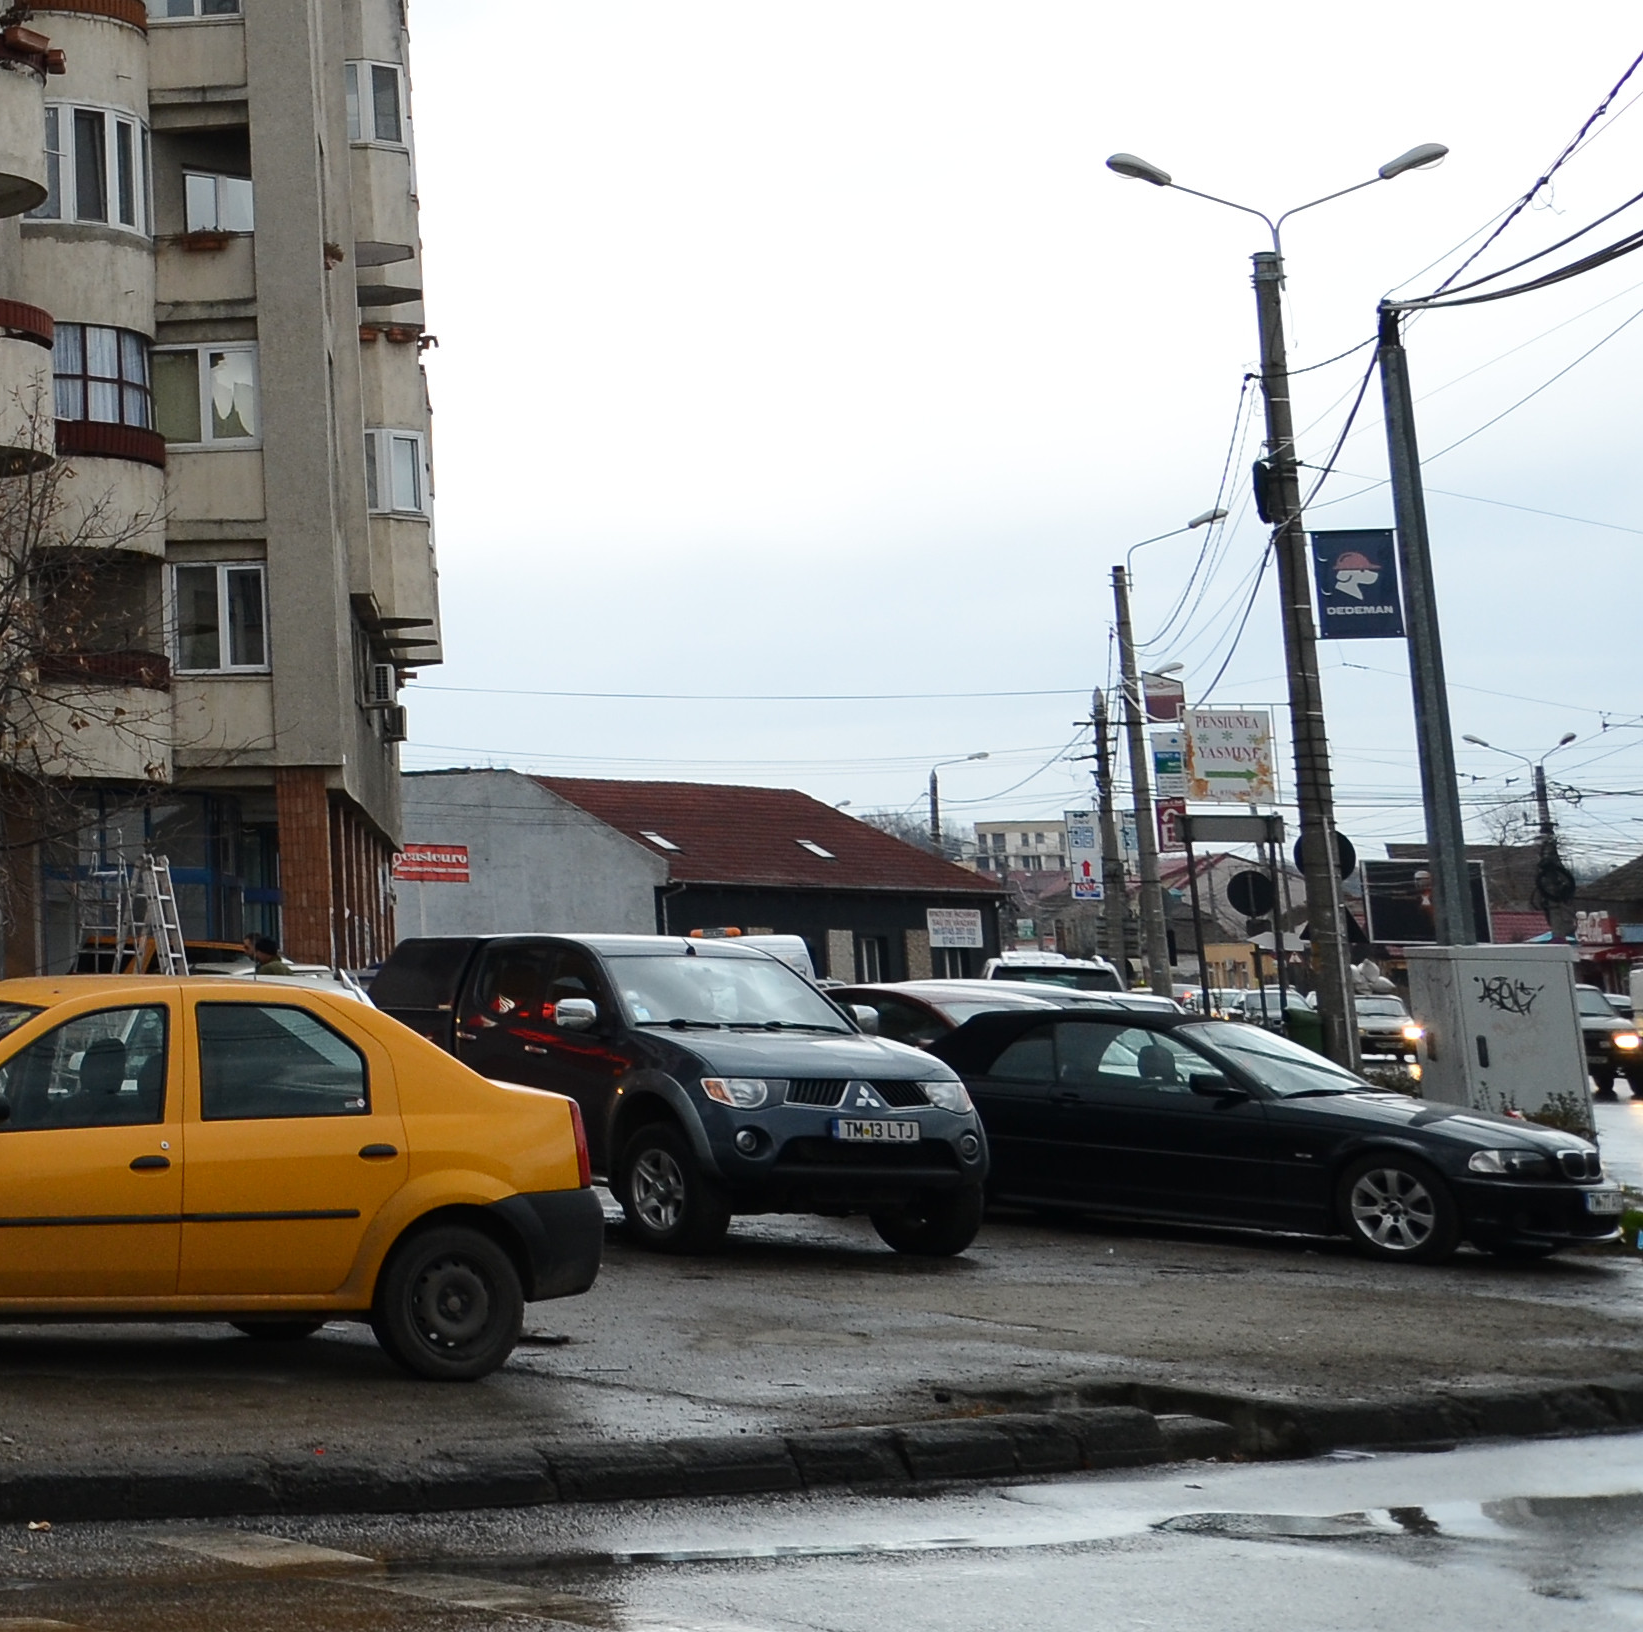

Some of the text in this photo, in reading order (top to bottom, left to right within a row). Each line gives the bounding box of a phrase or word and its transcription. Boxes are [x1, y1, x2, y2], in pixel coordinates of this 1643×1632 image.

[1326, 605, 1394, 616] DEDEMAN
[1195, 715, 1259, 729] PENSIUNEA
[844, 1122, 914, 1139] TM 13 LTJ
